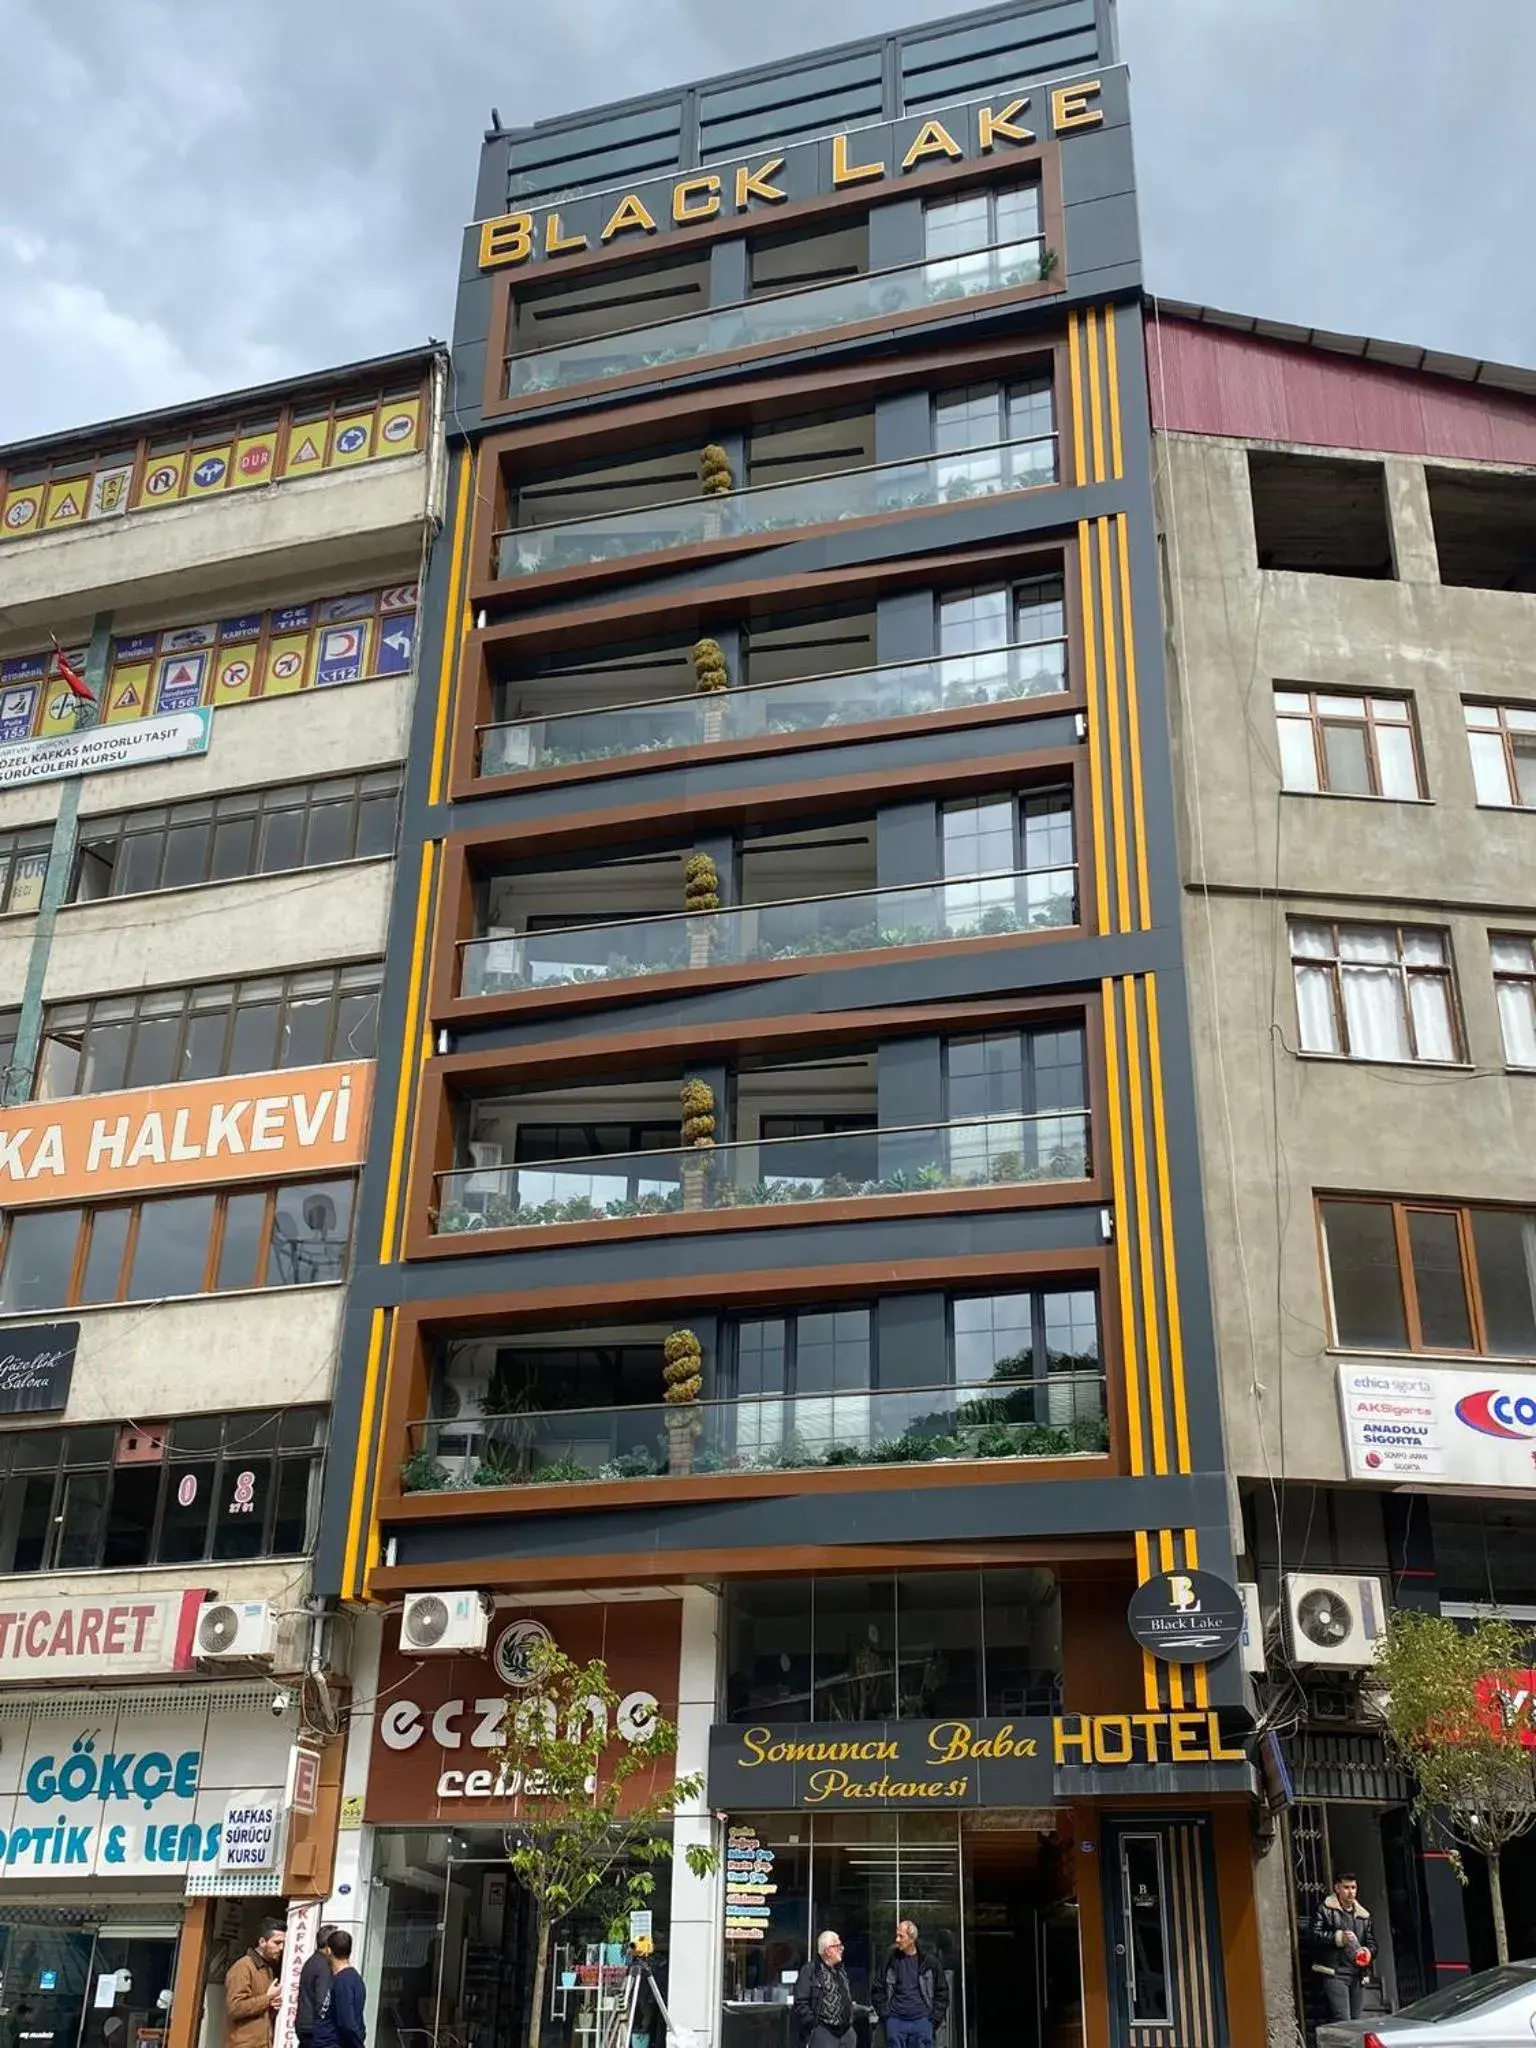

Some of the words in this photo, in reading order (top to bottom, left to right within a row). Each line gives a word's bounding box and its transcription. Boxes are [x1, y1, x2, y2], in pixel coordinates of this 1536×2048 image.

[478, 157, 787, 269] BLACK
[833, 80, 1104, 184] LAKE
[242, 451, 269, 469] DUR
[330, 668, 357, 681] 112
[170, 698, 195, 709] 156
[3, 727, 26, 740] 155
[31, 746, 79, 763] KAFKAS
[81, 735, 142, 753] MOTORLU
[144, 727, 180, 744] TAŞIT
[80, 750, 128, 767] KURSU
[86, 1074, 352, 1173] HALKEVİ
[1354, 1376, 1389, 1390] ethica
[1391, 1380, 1431, 1394] sigorta
[1363, 1423, 1429, 1436] ANADOLU
[1363, 1434, 1423, 1446] SİGORTA
[1151, 1618, 1186, 1631] Black
[1190, 1616, 1223, 1629] Lake
[381, 1690, 660, 1751] eczane
[738, 1726, 900, 1767] Somuncu
[926, 1721, 1037, 1766] Baba
[1053, 1711, 1247, 1764] HOTEL
[26, 1729, 201, 1811] GÖKÇE
[804, 1768, 968, 1802] Pastanesi
[228, 1808, 273, 1824] KAFKAS
[225, 1825, 272, 1844] SÜRÜCÜ
[103, 1825, 126, 1863] &
[227, 1847, 266, 1864] KURSU
[291, 1908, 308, 1978] KAFKAS
